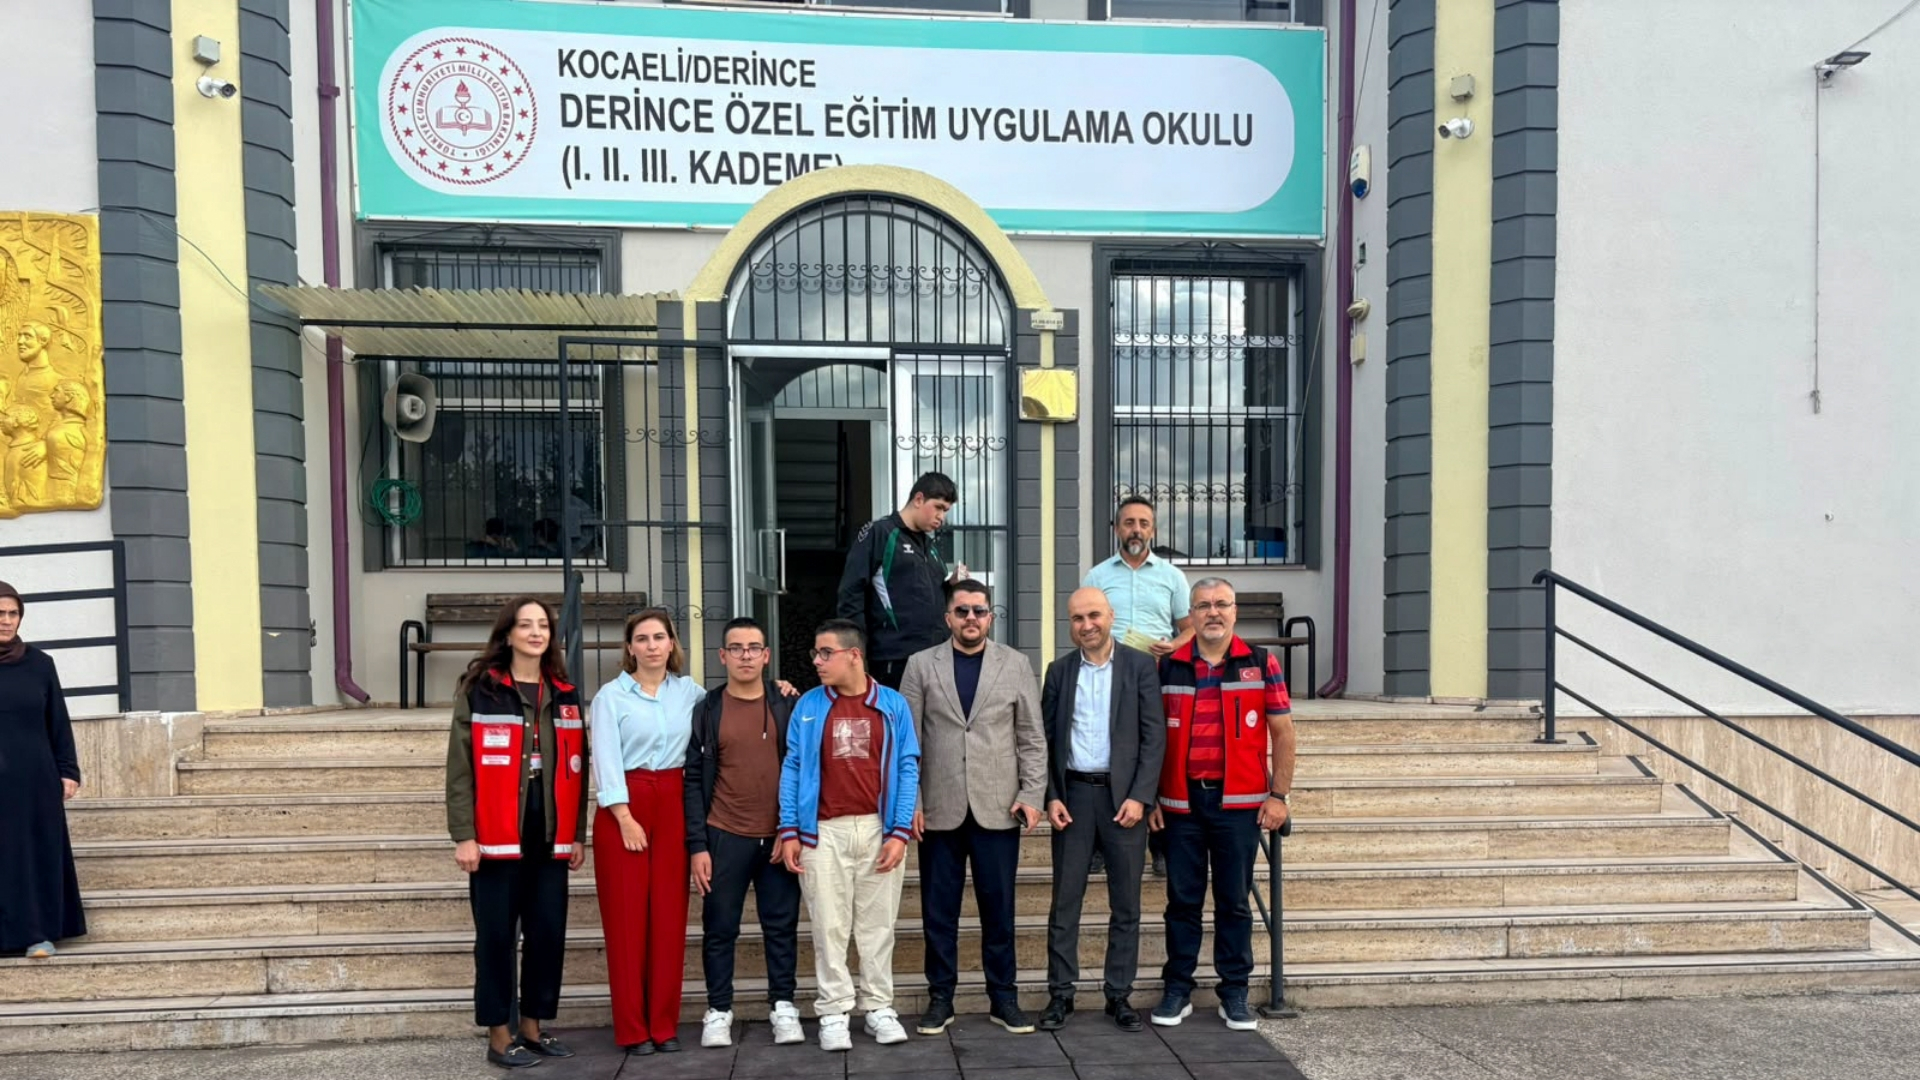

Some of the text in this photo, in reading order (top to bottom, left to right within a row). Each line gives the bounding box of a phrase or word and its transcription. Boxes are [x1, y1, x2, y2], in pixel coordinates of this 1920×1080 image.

[558, 48, 816, 88] KOCAELİ/DERİNCE
[560, 87, 1253, 147] DERİNCE ÖZEL EĞİTİM UYGULAMA OKULU
[562, 145, 591, 190] (I.
[603, 146, 630, 182] II.
[641, 148, 677, 183] III.
